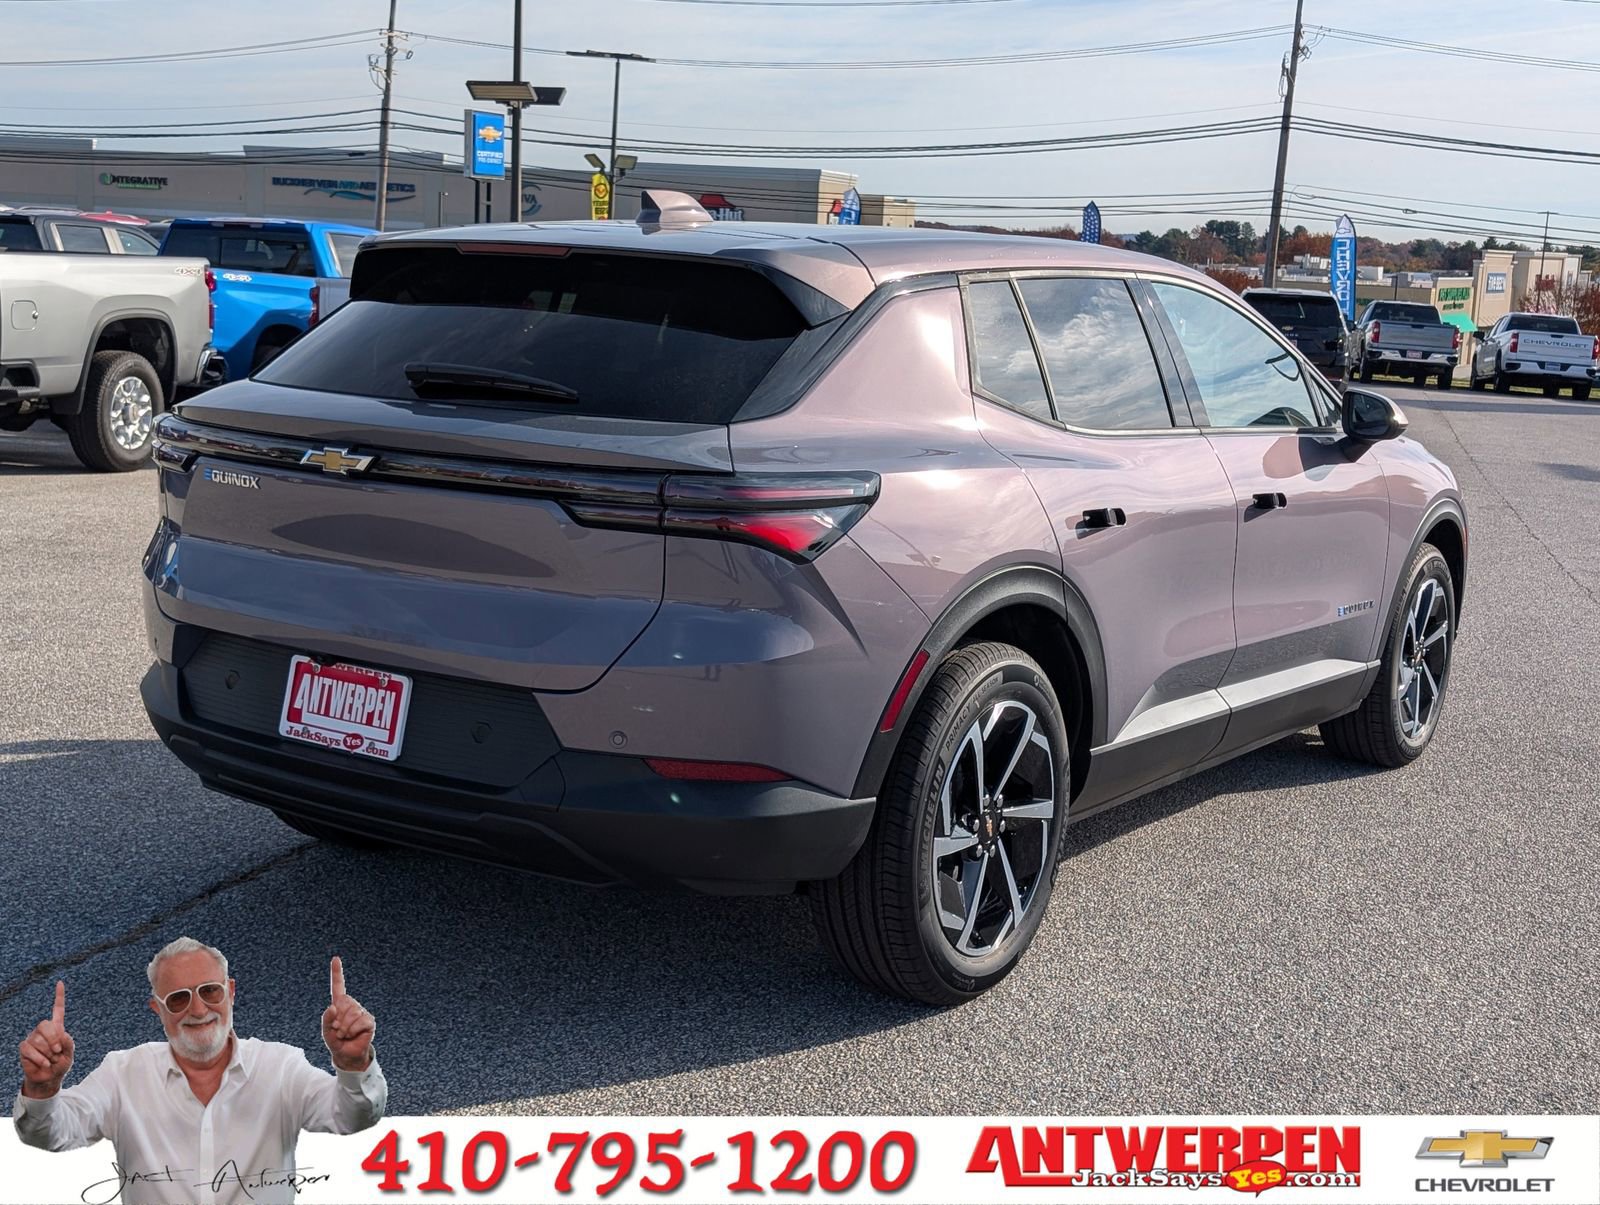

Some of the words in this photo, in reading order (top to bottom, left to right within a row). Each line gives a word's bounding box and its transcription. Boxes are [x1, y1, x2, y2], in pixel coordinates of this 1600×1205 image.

[1523, 338, 1590, 349] CHEVROLET
[204, 467, 261, 490] EQUINOX
[293, 672, 397, 731] ANTWERPEN
[945, 702, 972, 752] PRIMACY
[919, 762, 945, 871] MICHELIN
